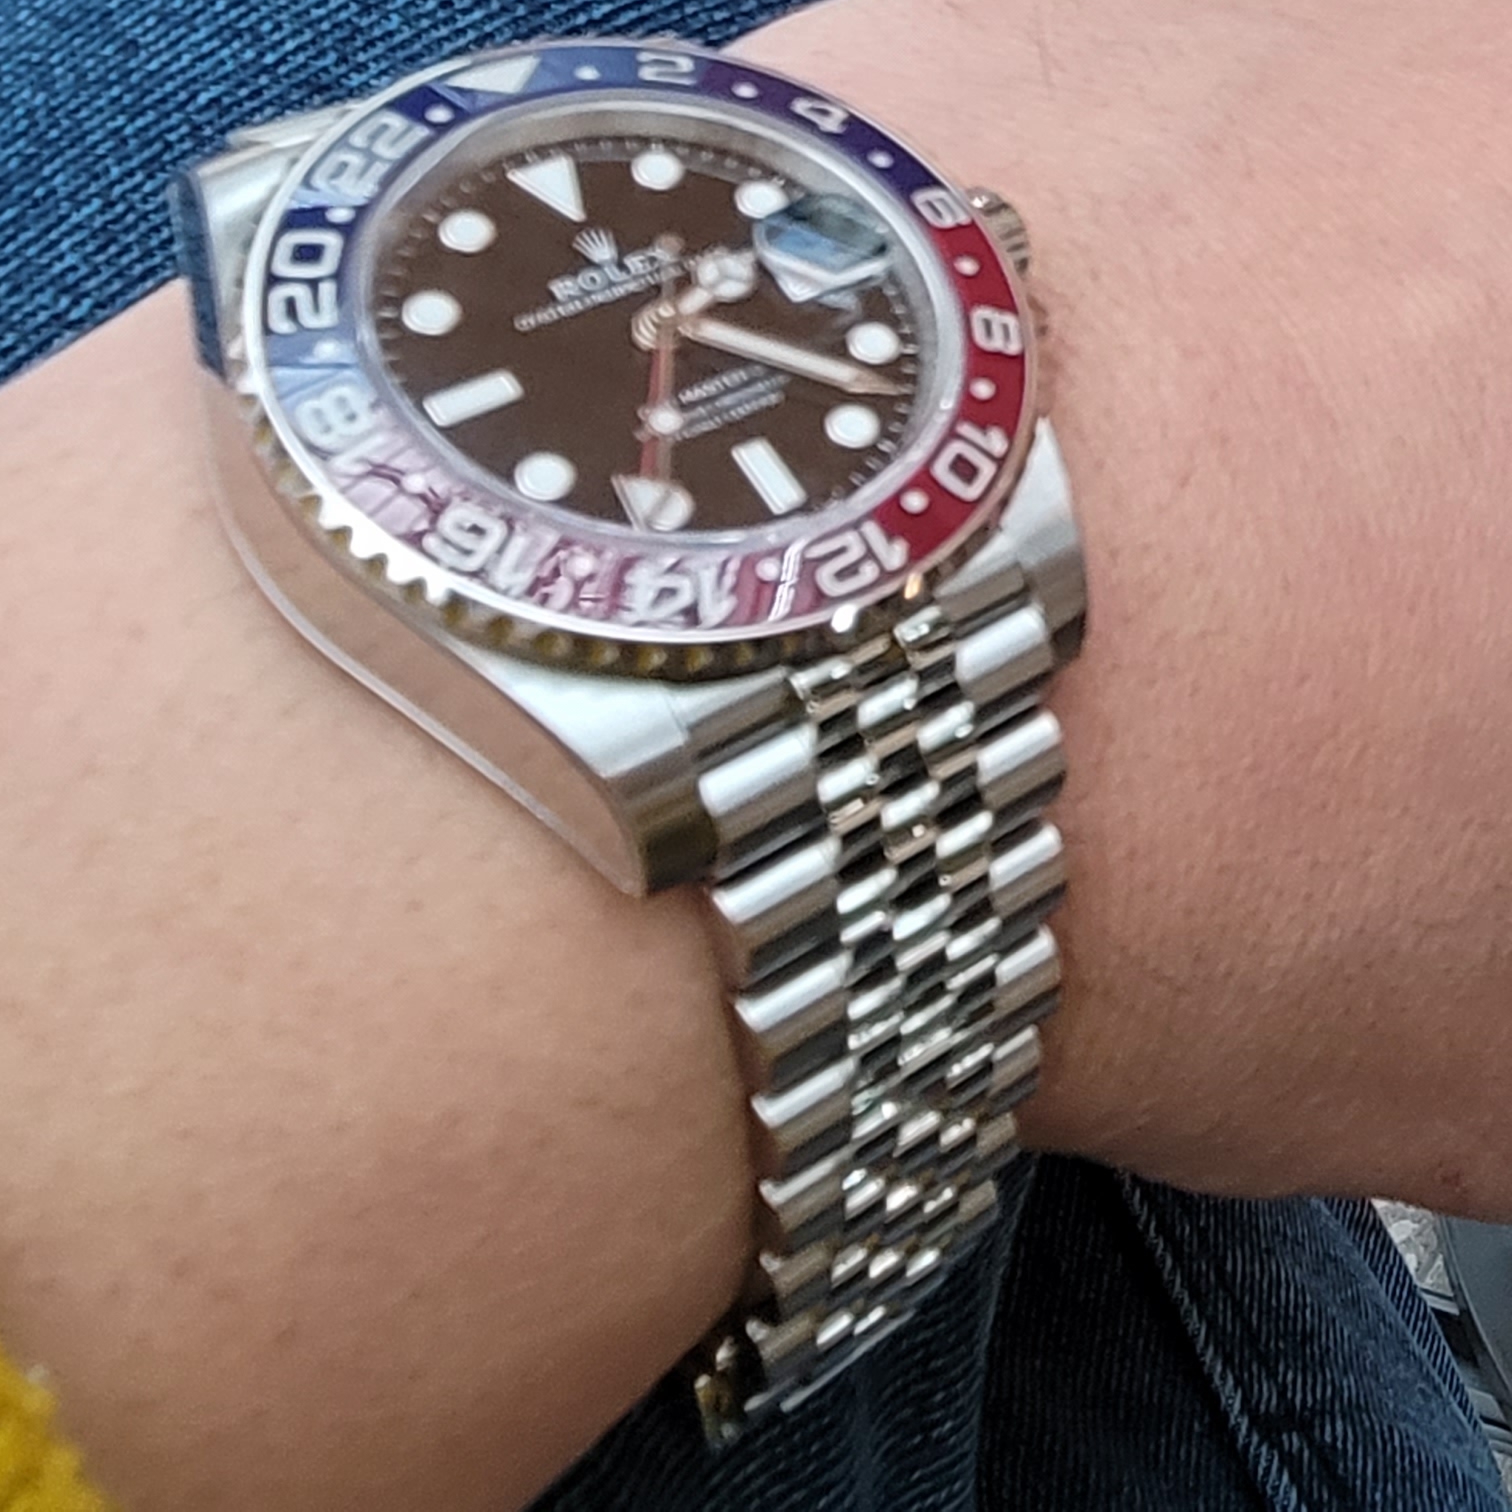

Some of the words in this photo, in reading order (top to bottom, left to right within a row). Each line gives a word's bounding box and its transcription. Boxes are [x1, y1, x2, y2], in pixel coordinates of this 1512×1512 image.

[635, 50, 698, 86] 2
[791, 95, 851, 134] 4
[308, 107, 434, 206] 22
[910, 185, 972, 229] 6
[267, 226, 345, 334] 20
[969, 305, 1023, 356] 8
[929, 420, 1008, 502] 10
[421, 501, 560, 597] 16
[802, 519, 909, 598] 12
